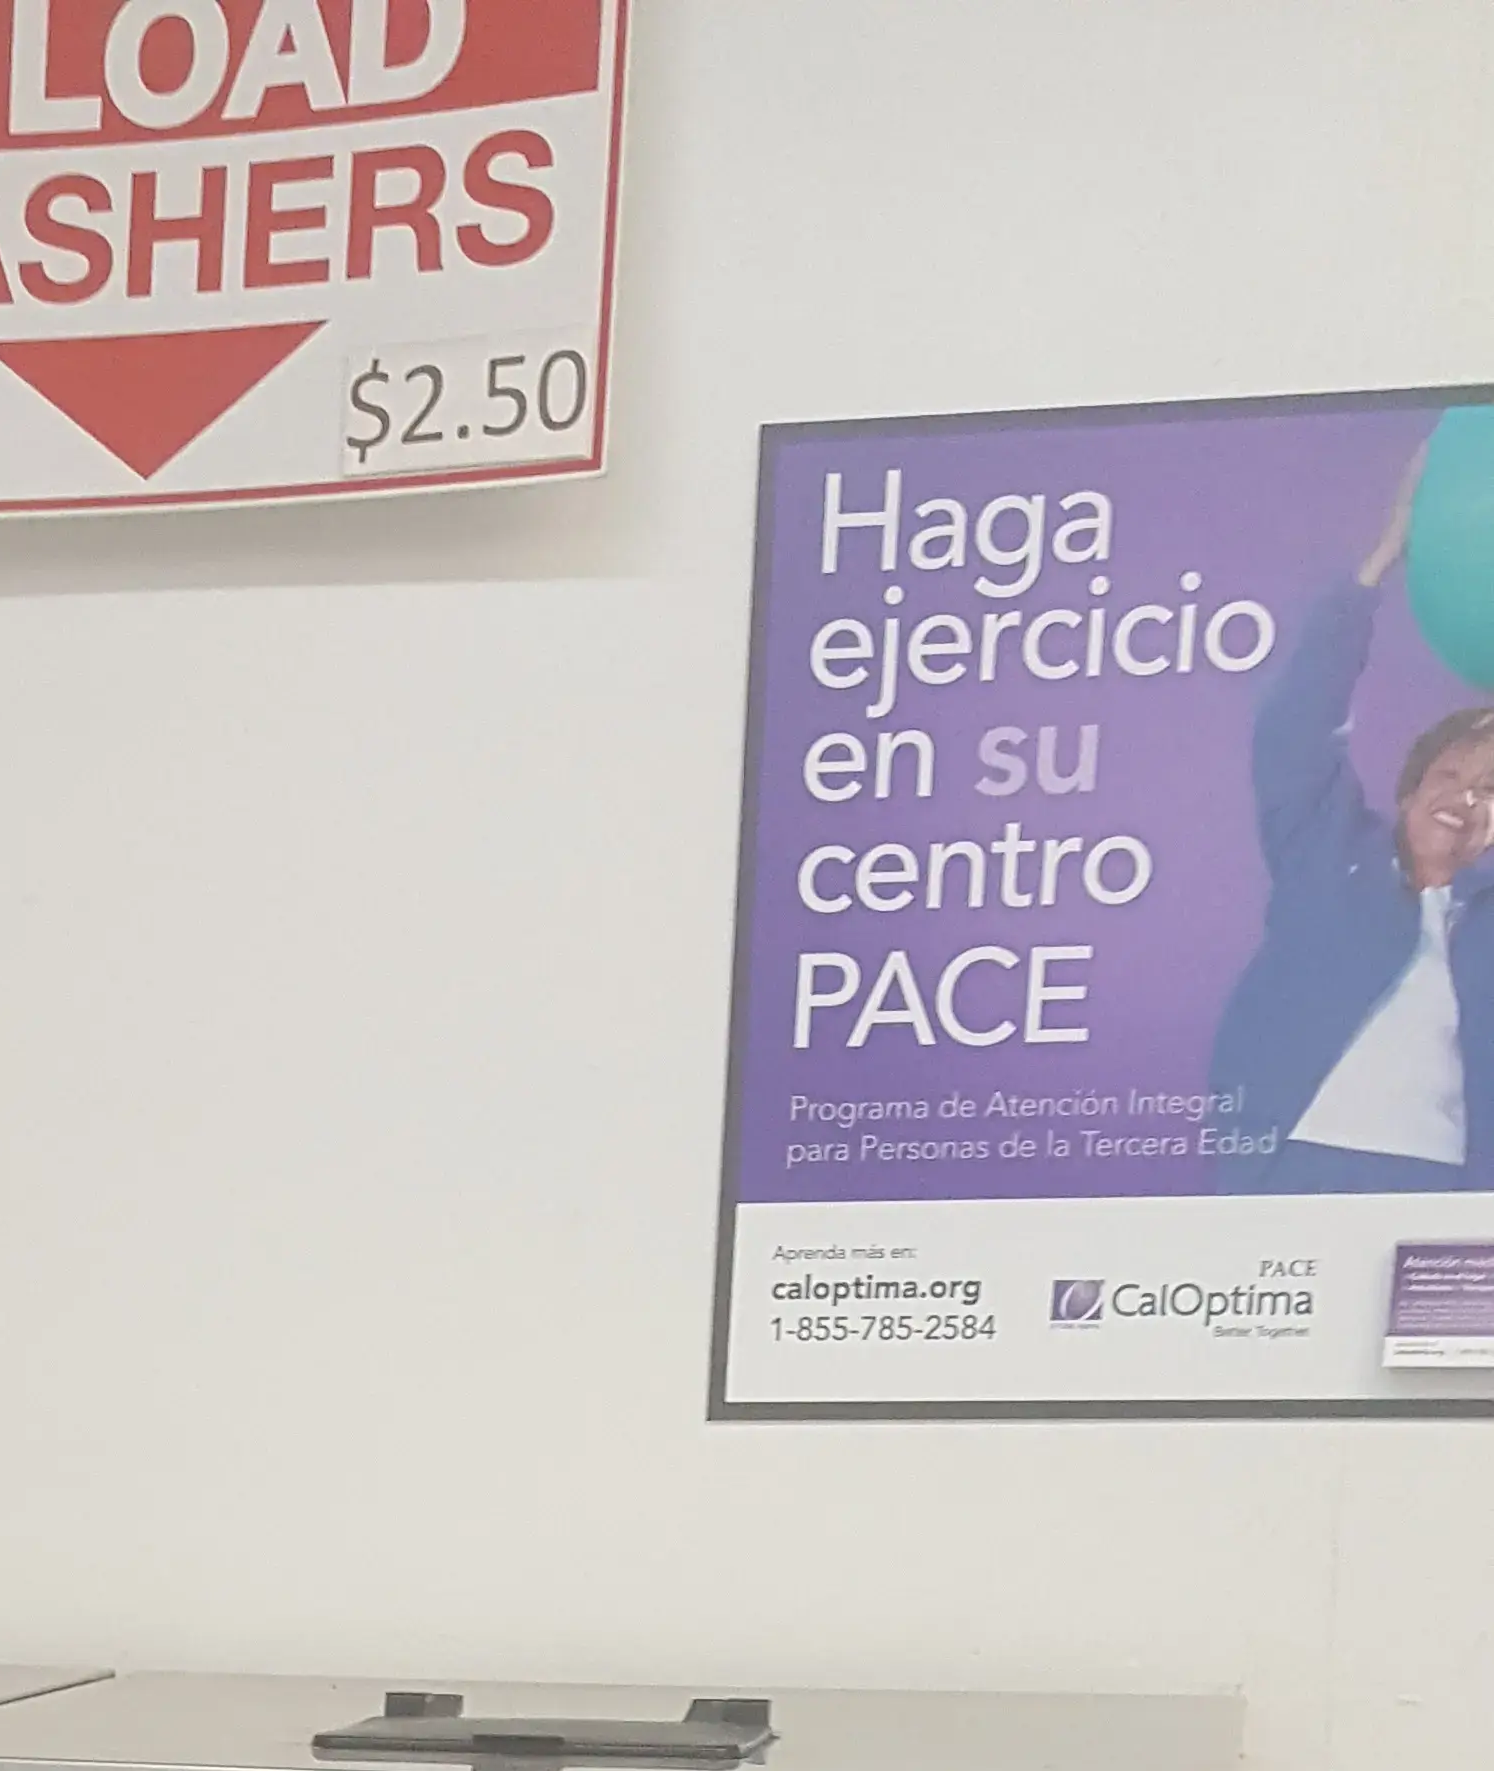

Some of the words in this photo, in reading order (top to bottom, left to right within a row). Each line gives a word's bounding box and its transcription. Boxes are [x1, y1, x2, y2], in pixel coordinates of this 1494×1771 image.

[8, 0, 466, 135] LOAD
[346, 349, 587, 463] $2.50
[821, 468, 1112, 597] Haga
[809, 572, 1276, 718] ejercicio
[803, 729, 934, 802] en
[975, 724, 1099, 797] su
[796, 822, 1153, 913] centro
[793, 944, 1094, 1049] PACE
[790, 1095, 930, 1128] Programa
[938, 1091, 976, 1119] de
[984, 1088, 1118, 1119] Atención
[1128, 1085, 1244, 1121] Integral
[785, 1142, 849, 1169] para
[860, 1135, 990, 1161] Personas
[998, 1130, 1037, 1158] de
[1046, 1129, 1071, 1157] la
[1080, 1130, 1188, 1157] Tercera
[1198, 1126, 1278, 1155] Edad
[772, 1245, 846, 1264] Aprenda
[1258, 1259, 1317, 1278] PACE
[771, 1274, 982, 1306] caloptima.org
[1112, 1283, 1314, 1326] CalOptima
[770, 1314, 997, 1342] 1-855-785-2584
